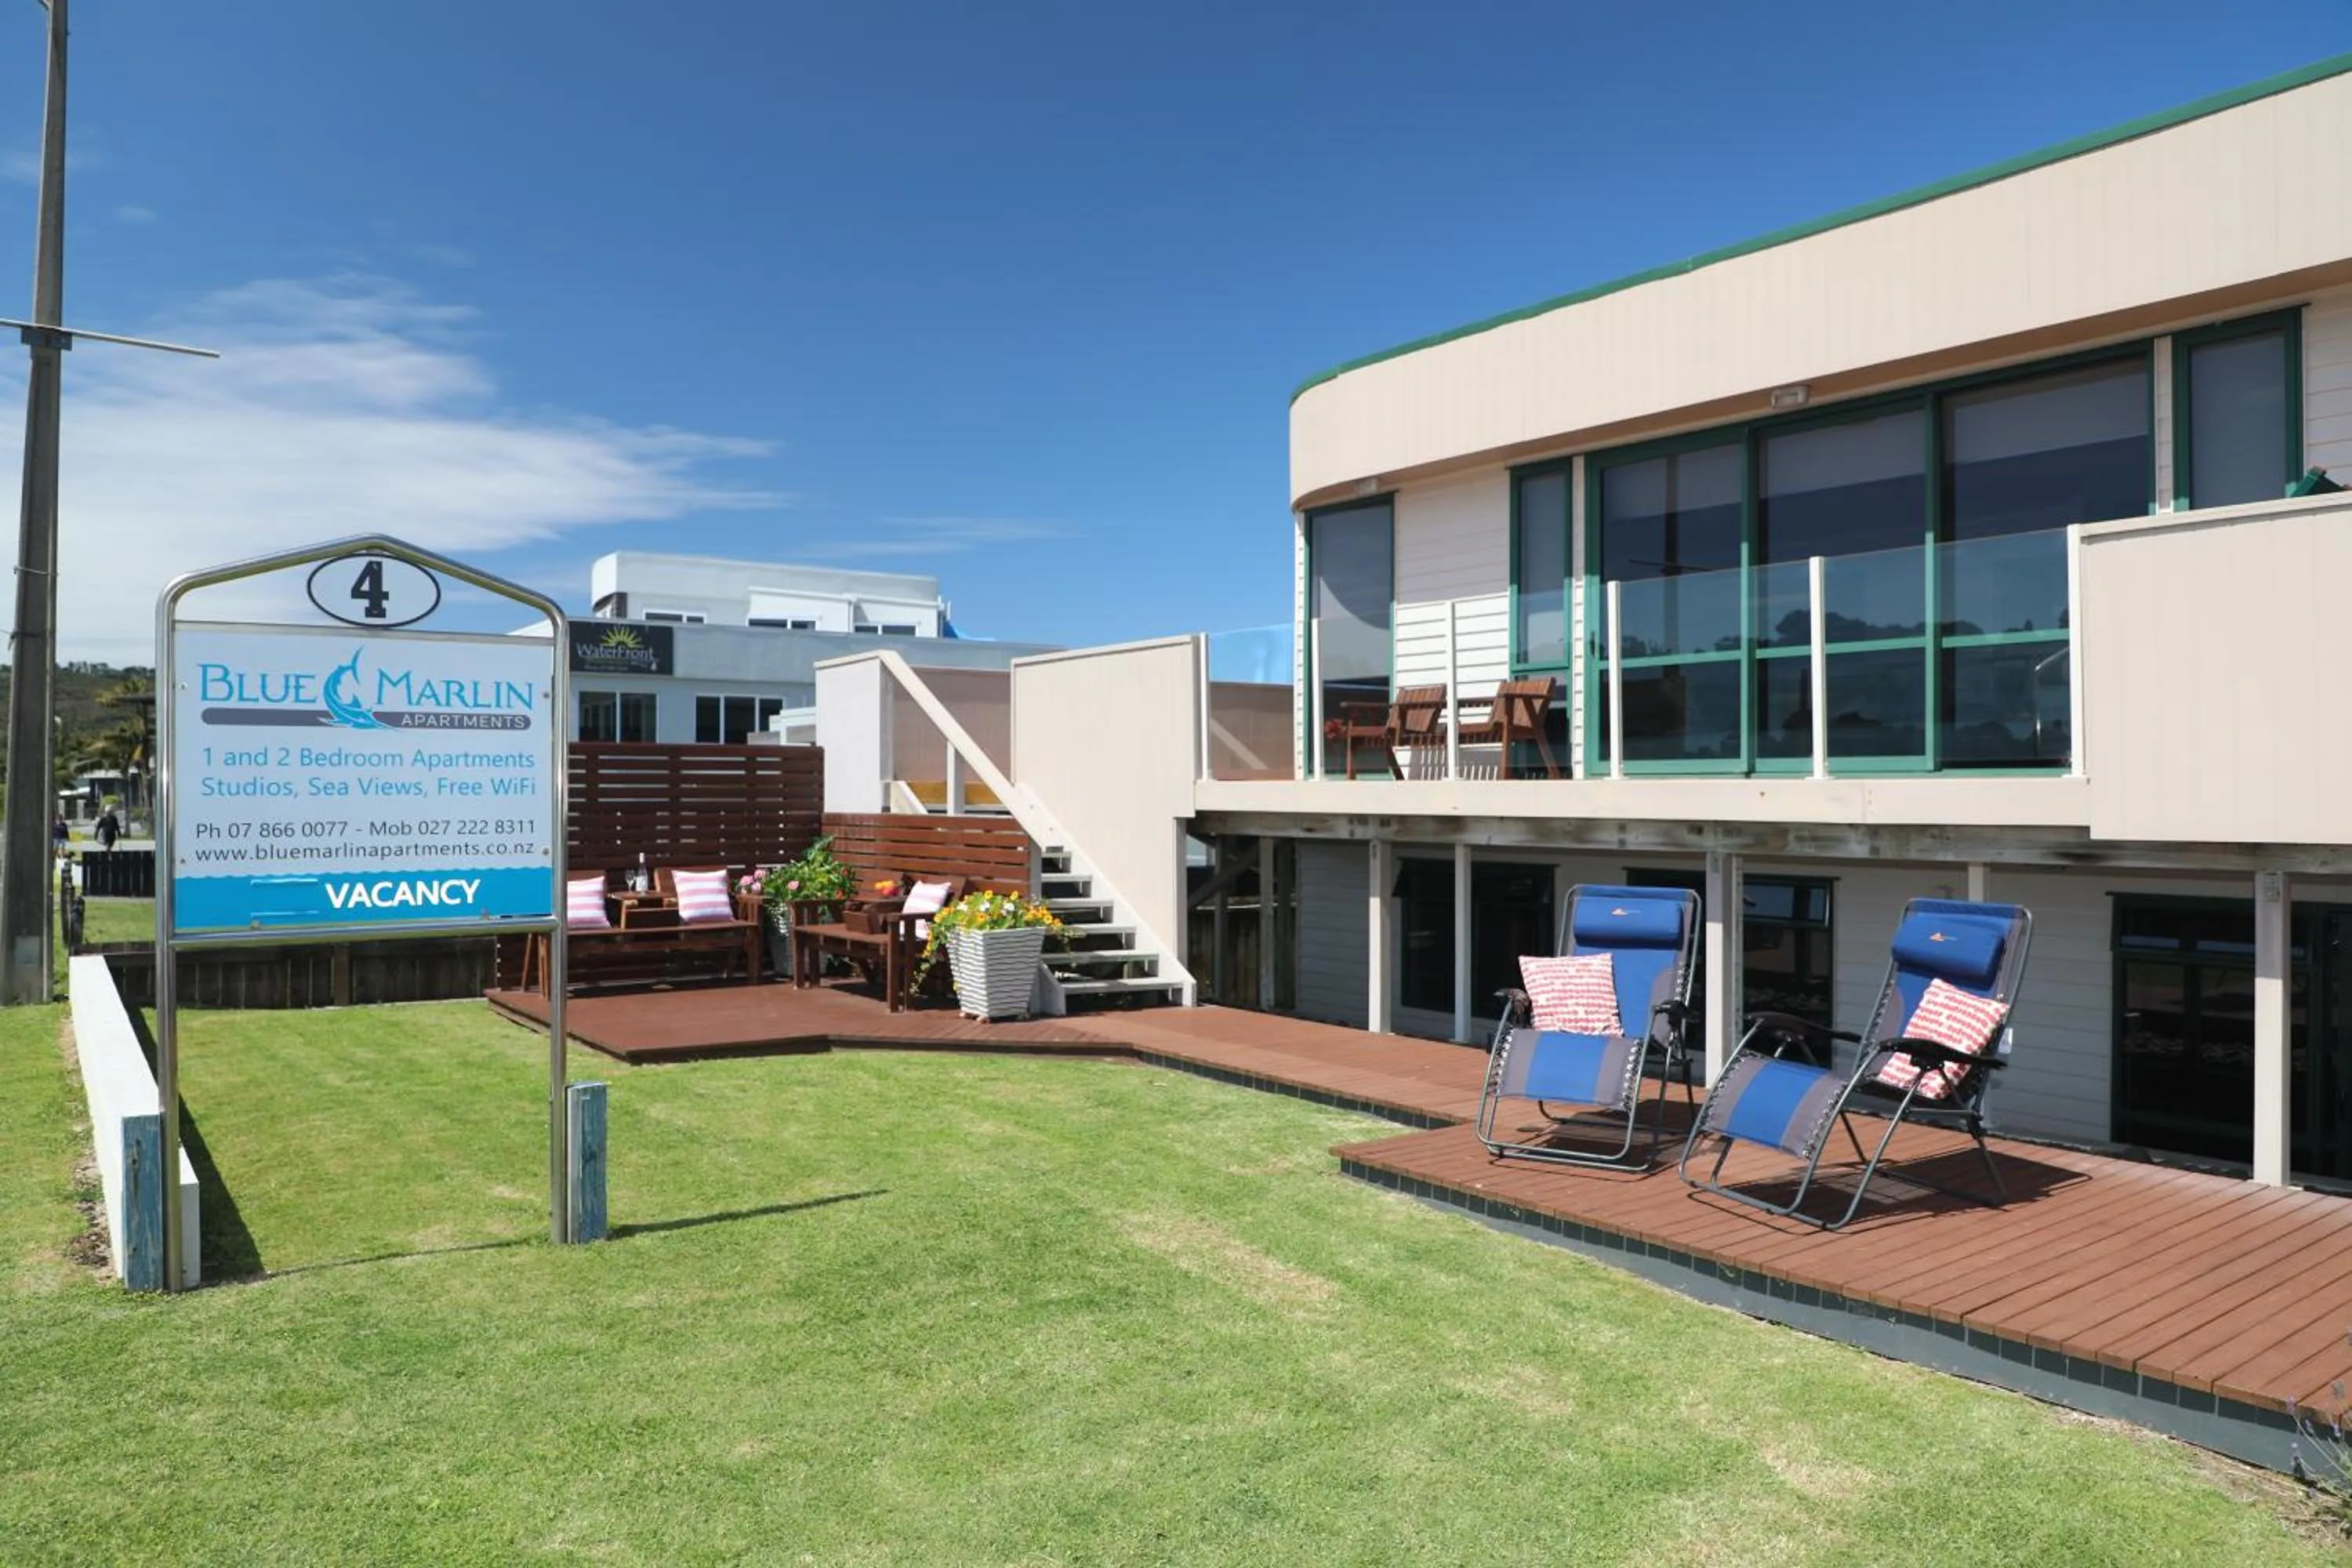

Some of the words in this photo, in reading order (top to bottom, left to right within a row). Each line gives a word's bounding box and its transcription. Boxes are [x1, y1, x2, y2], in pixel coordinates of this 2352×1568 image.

[350, 561, 389, 618] 4
[401, 714, 524, 729] APARTMENTS
[204, 748, 212, 766] 1
[223, 748, 267, 767] and
[278, 748, 289, 766] 2
[301, 749, 403, 767] Bedroom
[412, 750, 535, 771] Apartments
[202, 777, 299, 798] Studios,
[310, 778, 349, 797] Sea
[360, 778, 427, 799] Views,
[438, 778, 481, 796] Free
[492, 777, 535, 795] WiFi
[196, 823, 220, 839] Ph
[228, 822, 251, 839] 07
[260, 822, 295, 838] 866
[302, 822, 347, 837] 0077
[370, 820, 412, 836] Mob
[419, 820, 451, 835] 027
[457, 820, 488, 835] 222
[495, 819, 535, 834] 8311
[196, 841, 534, 861] www.bluemarlinapartments.co.nz
[326, 880, 480, 909] VACANCY
